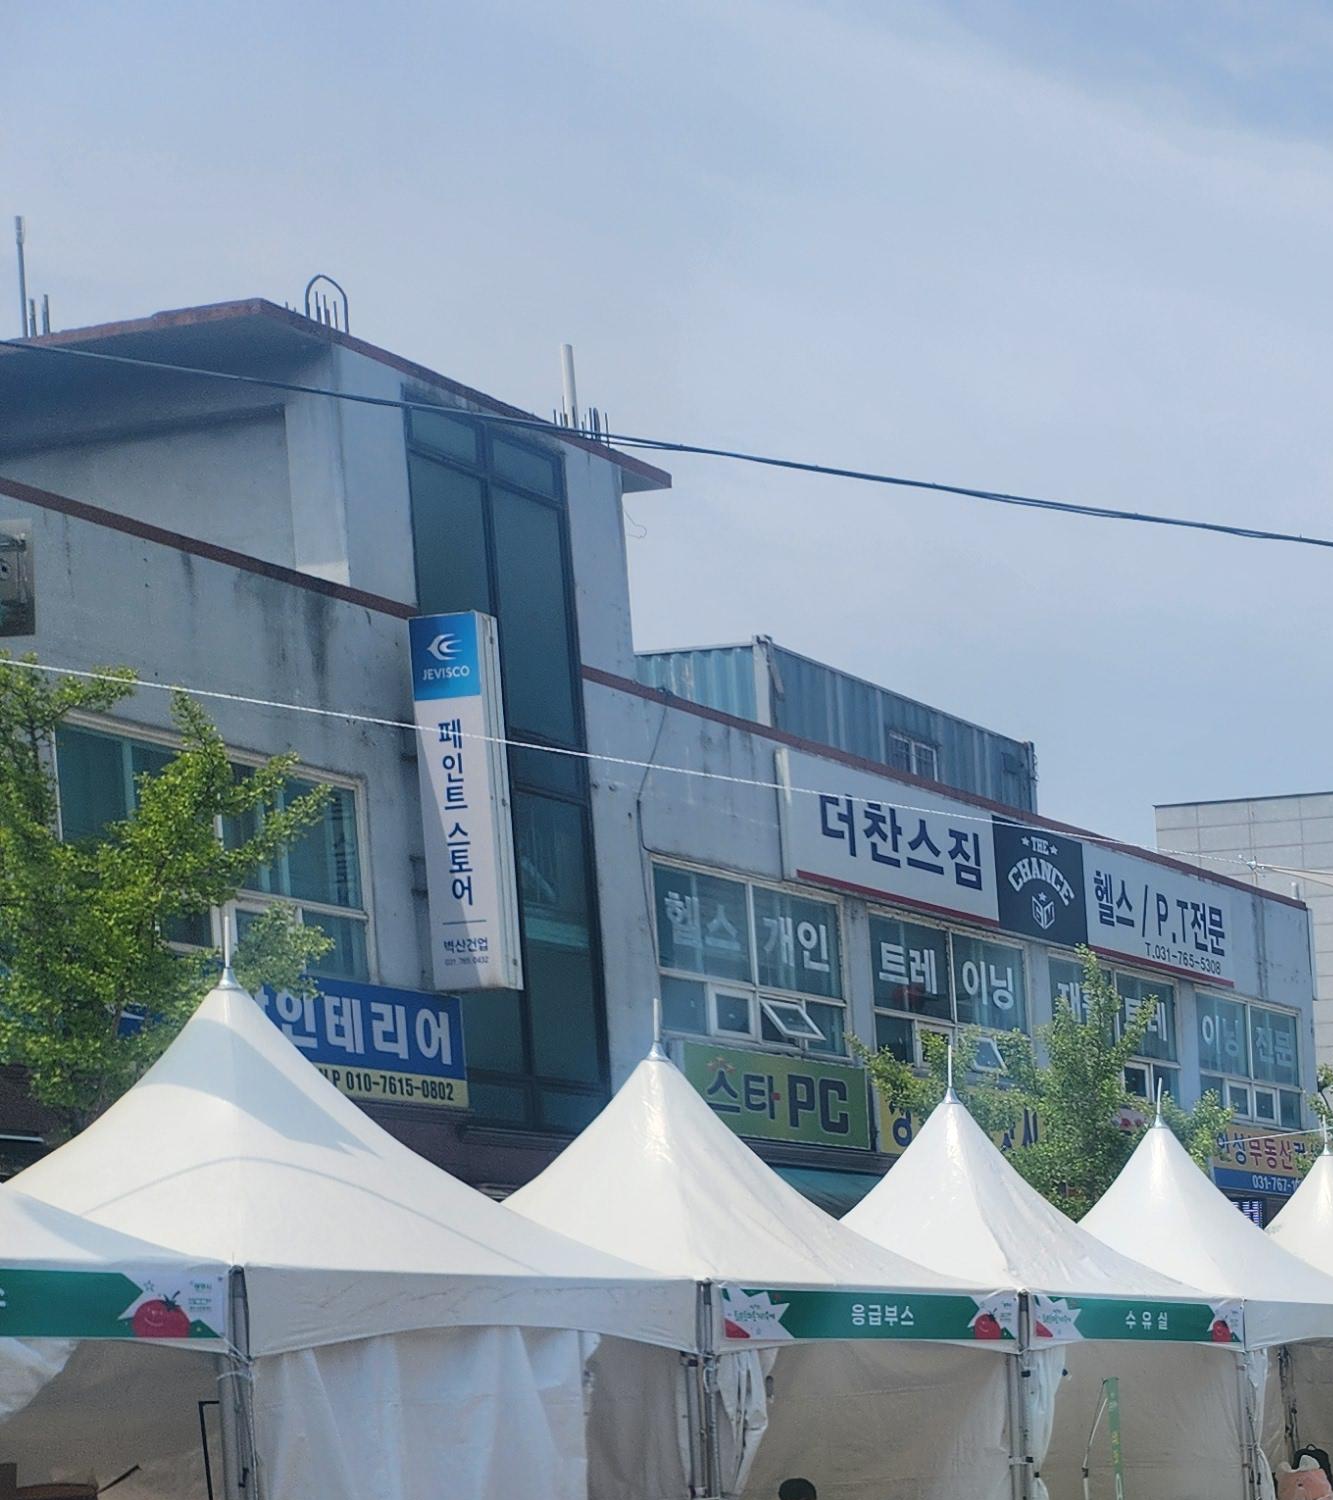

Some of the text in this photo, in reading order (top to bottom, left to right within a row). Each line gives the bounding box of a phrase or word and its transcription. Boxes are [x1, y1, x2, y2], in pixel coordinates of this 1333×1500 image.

[422, 664, 470, 681] JEVISCO
[437, 718, 474, 906] 페인트 스토어
[819, 793, 983, 891] 더찬스짐
[1030, 836, 1050, 856] THE
[1007, 856, 1075, 907] CHANCE
[663, 890, 742, 951] 헬스
[255, 985, 453, 1066] 인테리어
[346, 1070, 455, 1101] 010-7615-0802
[1252, 1174, 1301, 1192] 031-767-1
[850, 1303, 915, 1327] 응급부스
